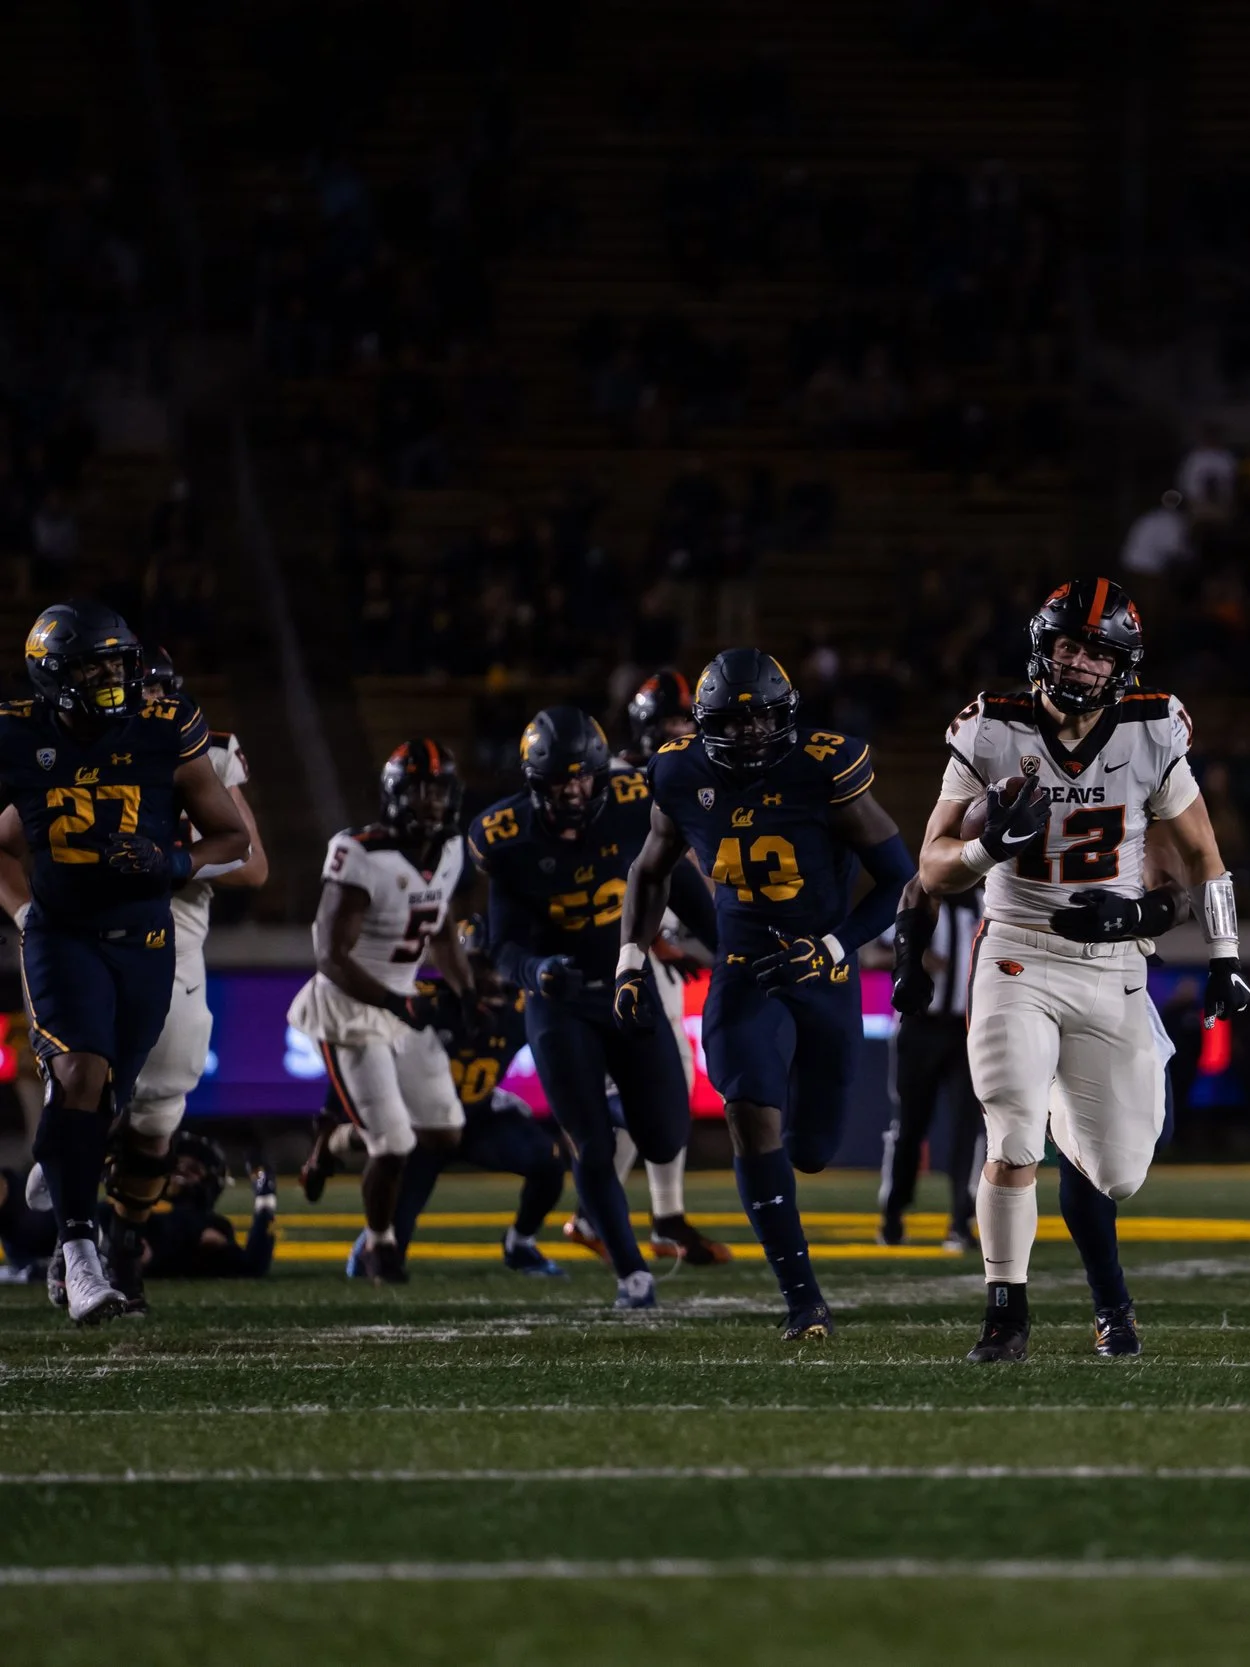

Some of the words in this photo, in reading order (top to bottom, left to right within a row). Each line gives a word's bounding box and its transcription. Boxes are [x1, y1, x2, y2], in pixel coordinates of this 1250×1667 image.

[803, 731, 846, 763] 43
[74, 766, 100, 786] Cal
[610, 772, 650, 805] 52
[46, 784, 141, 865] 27
[482, 808, 520, 845] 52
[730, 806, 755, 828] Cal
[711, 835, 805, 903] 43
[144, 927, 168, 949] Cal
[390, 905, 440, 963] 5
